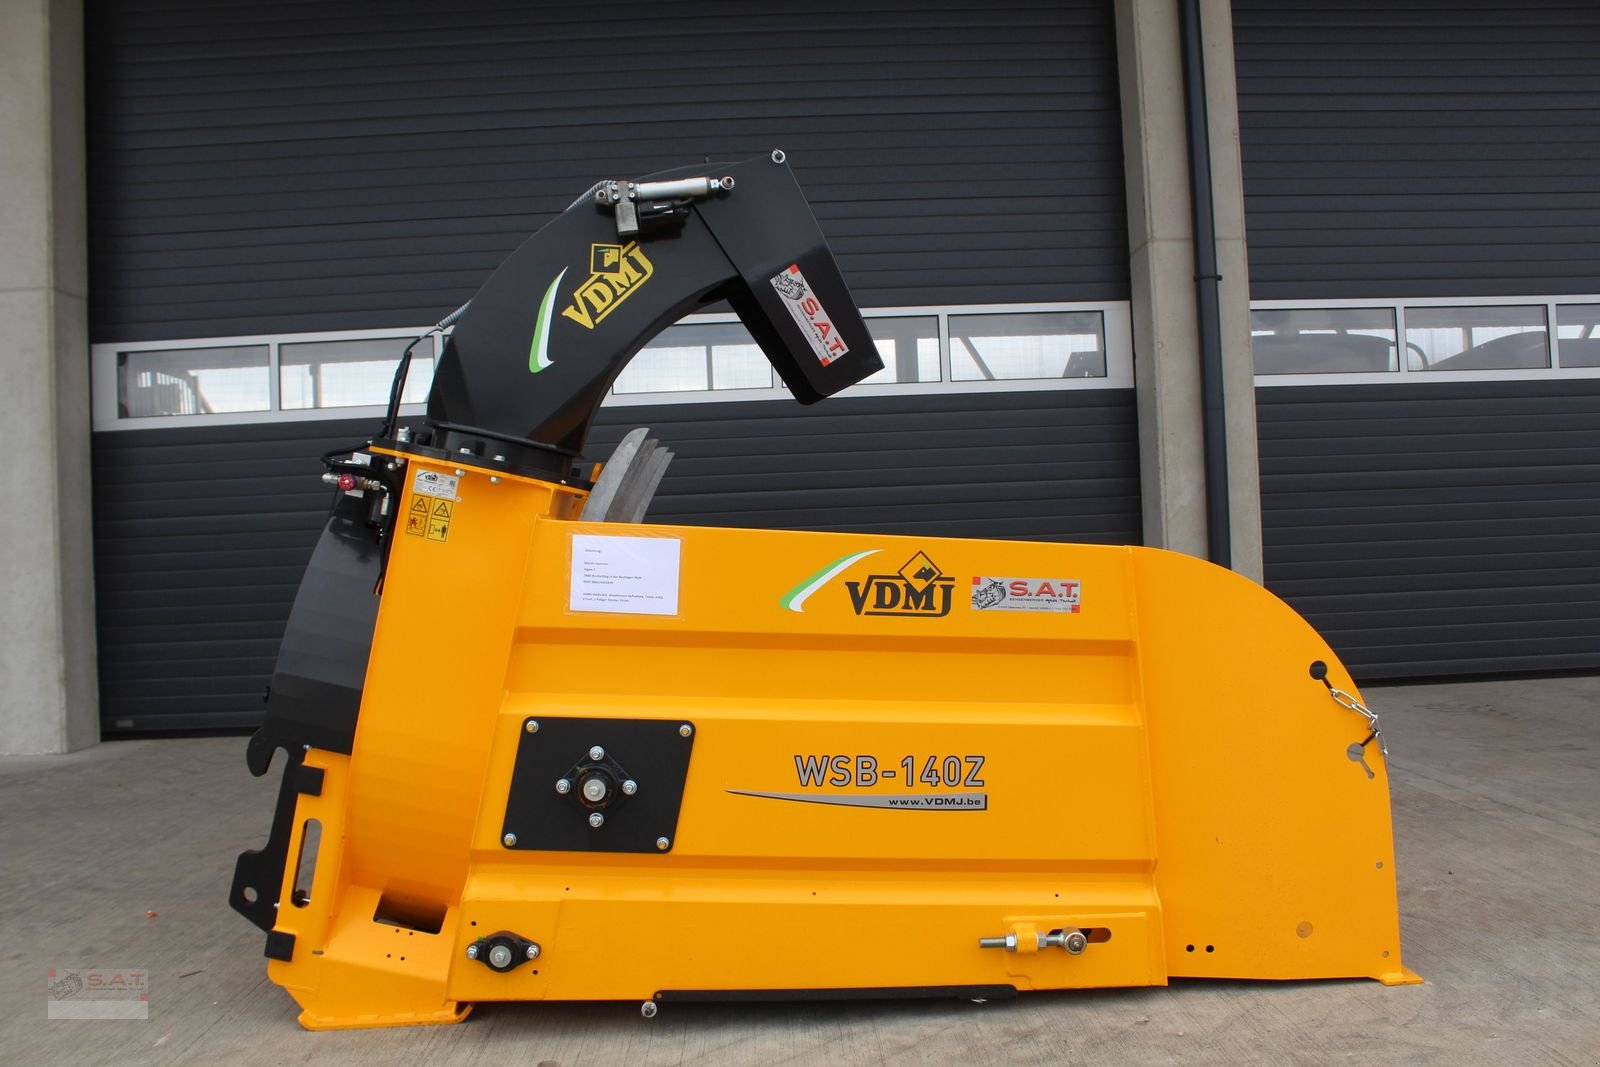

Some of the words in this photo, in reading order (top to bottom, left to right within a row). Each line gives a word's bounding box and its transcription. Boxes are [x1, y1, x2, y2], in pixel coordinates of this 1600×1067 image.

[562, 241, 654, 330] VDMJ
[801, 297, 846, 357] S.A.T.
[845, 575, 956, 617] VDMJ
[1009, 580, 1078, 598] S.A.T.
[794, 755, 985, 787] WSB-140Z
[889, 797, 981, 806] www.VDMJ.be
